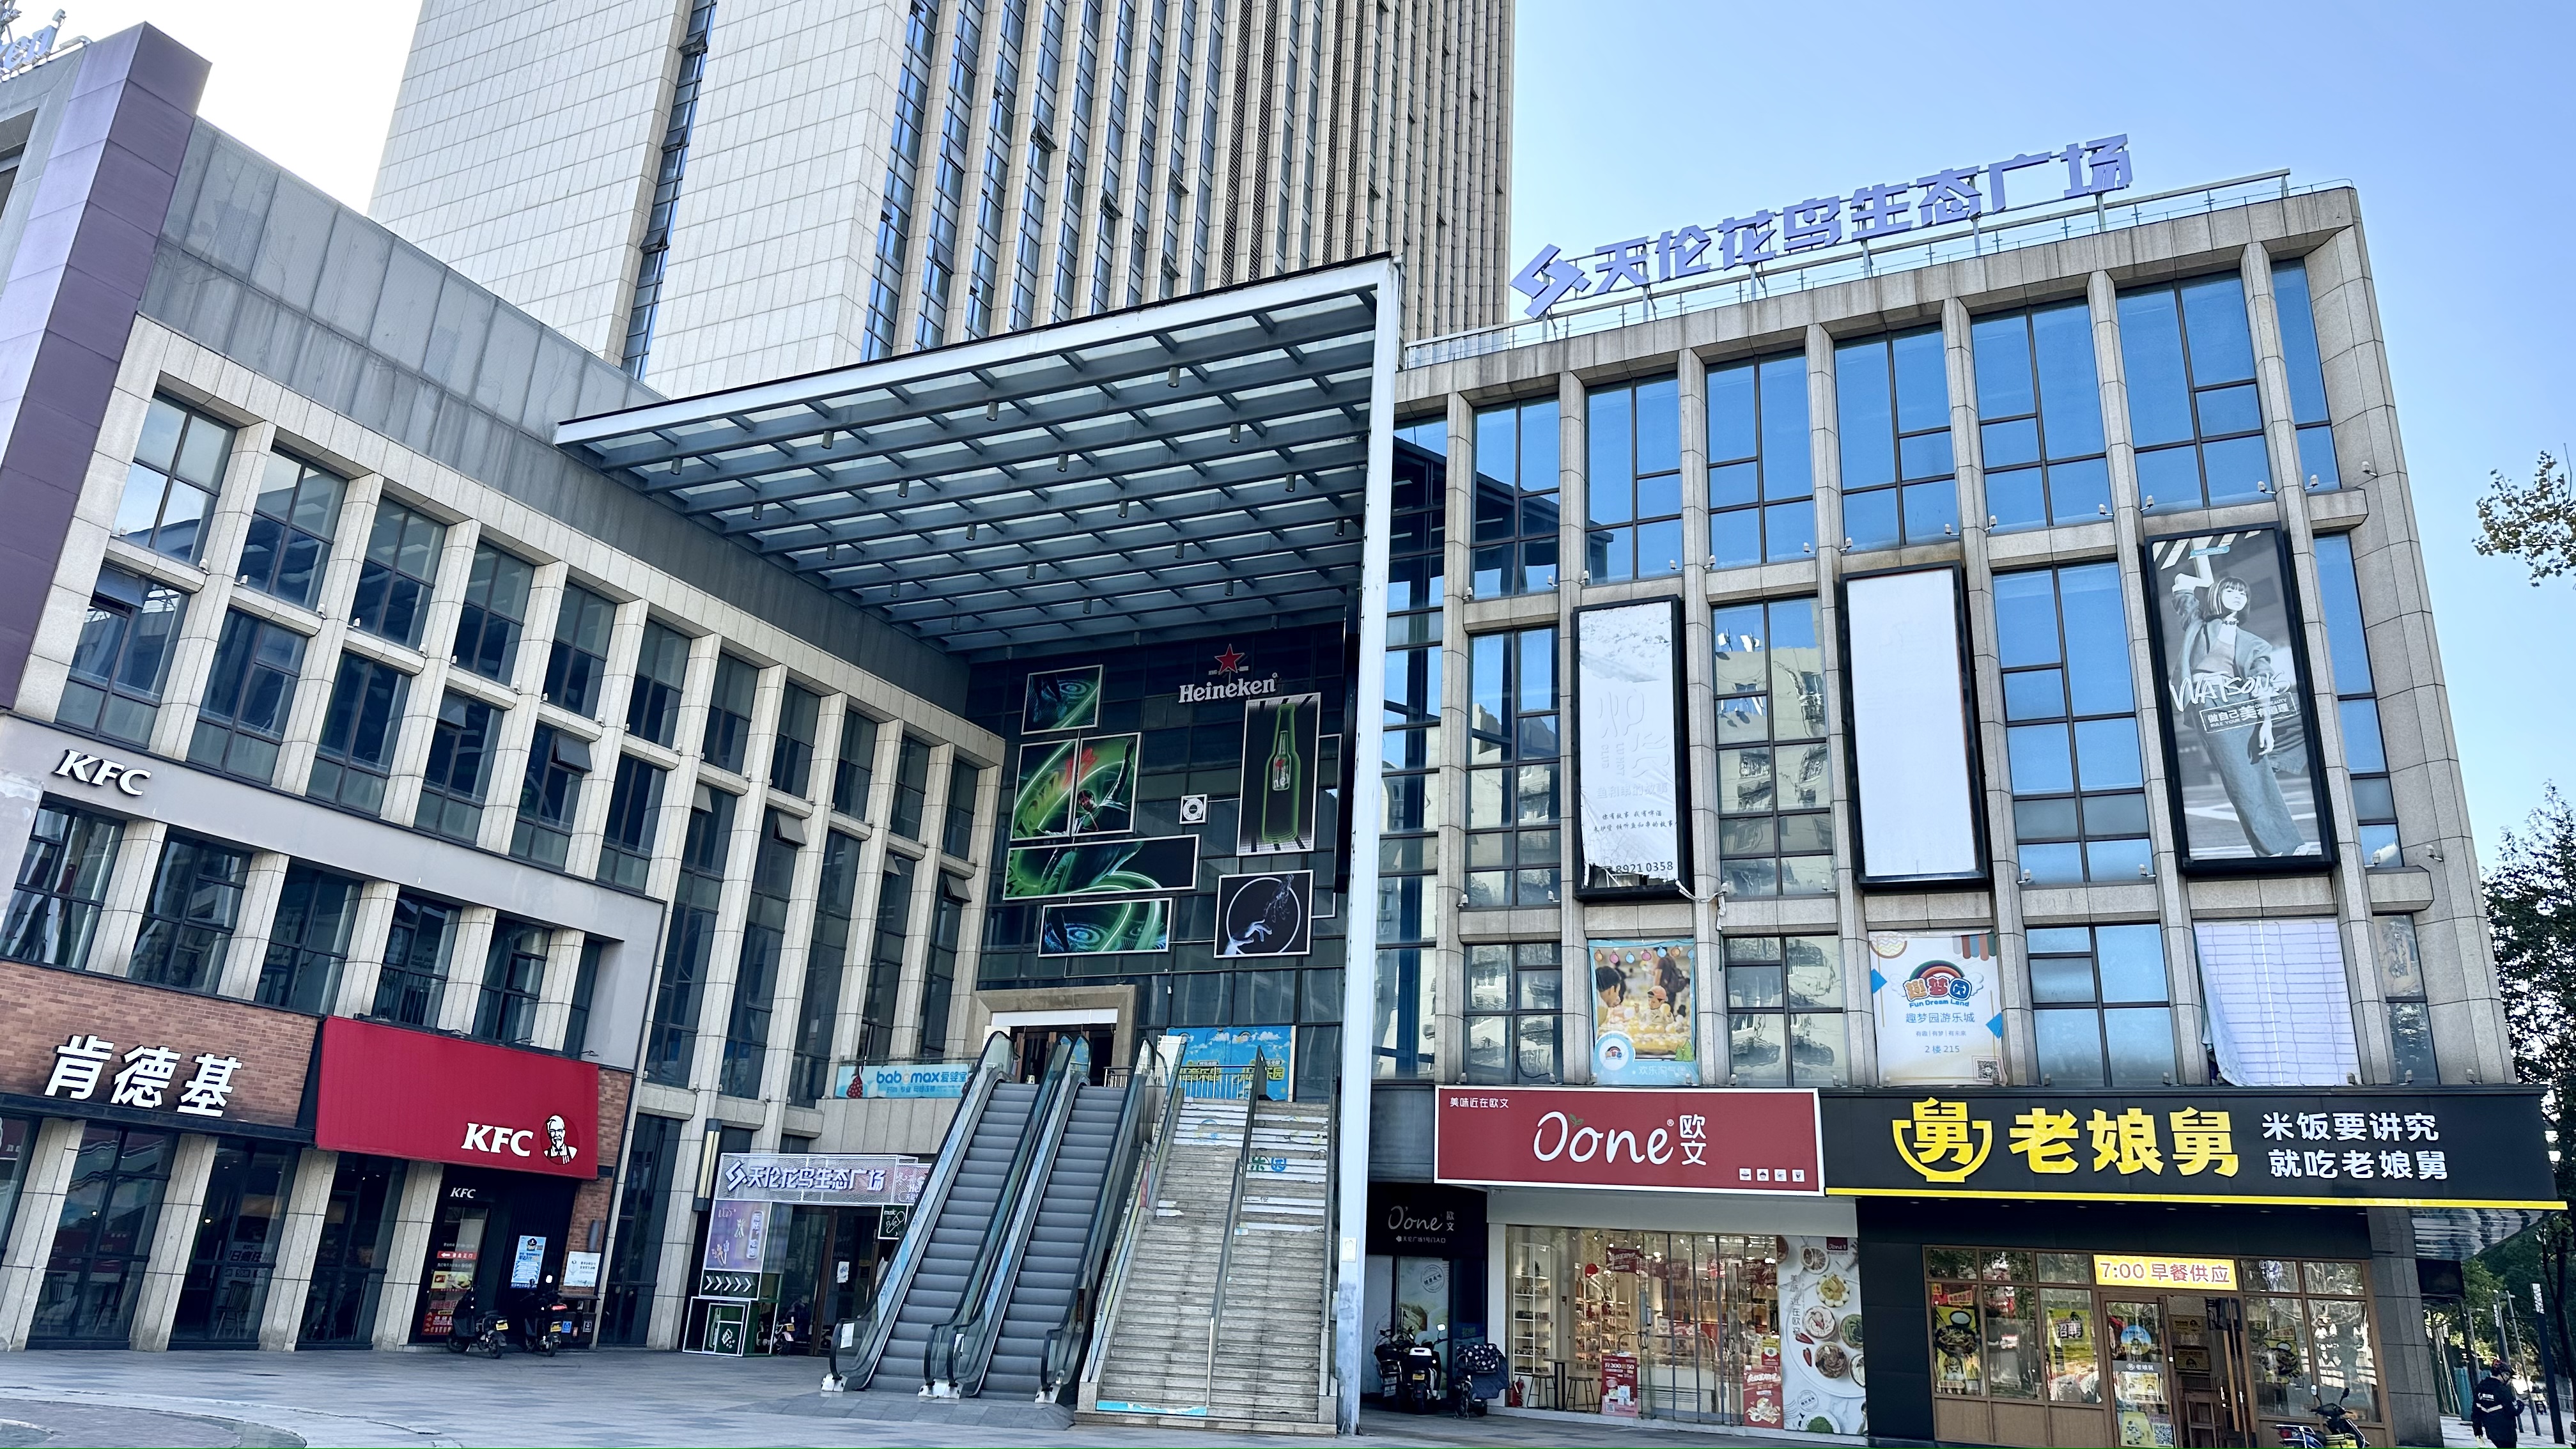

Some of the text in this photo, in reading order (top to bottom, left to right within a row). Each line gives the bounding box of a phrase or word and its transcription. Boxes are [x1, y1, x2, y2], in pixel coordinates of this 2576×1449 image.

[1594, 133, 2134, 295] 天伦花鸟生态广场
[1179, 678, 1276, 703] Heineken
[2169, 671, 2292, 712] WATSONS
[54, 749, 151, 796] KFC
[1646, 861, 1673, 872] 0358
[1905, 1012, 1975, 1023] 趣梦园游乐城
[44, 1035, 242, 1117] 肯德基
[1450, 1097, 1509, 1109] 美味近在欧文
[462, 1122, 534, 1158] KFC
[1679, 1114, 1707, 1166] 欧文
[2008, 1106, 2239, 1177] 老娘舅
[2262, 1112, 2440, 1142] 米饭要讲究
[747, 1167, 885, 1191] 天伦花鸟生态广场
[2267, 1149, 2449, 1180] 就吃老娘舅
[450, 1188, 476, 1198] KFC
[2100, 1263, 2230, 1283] 7:00 早餐供应
[2058, 1323, 2083, 1338] 招聘
